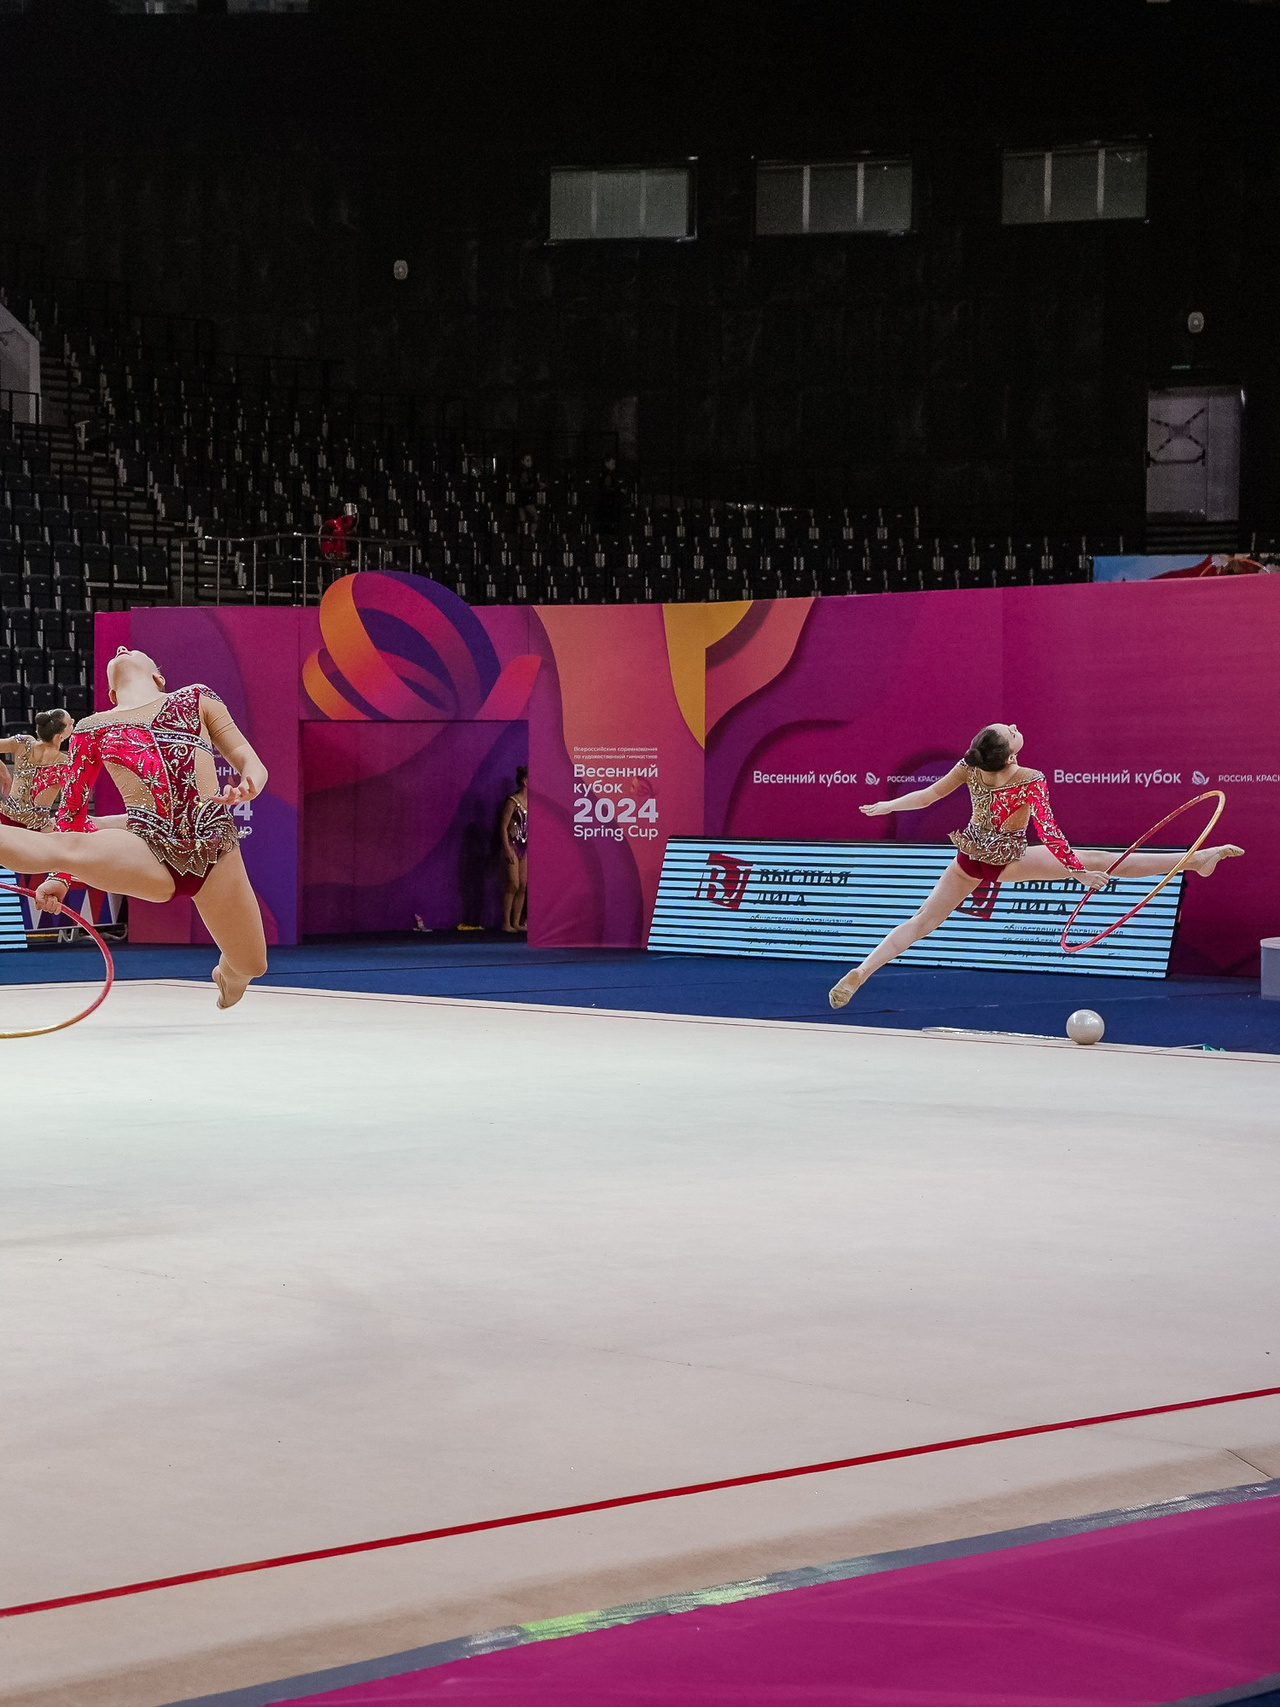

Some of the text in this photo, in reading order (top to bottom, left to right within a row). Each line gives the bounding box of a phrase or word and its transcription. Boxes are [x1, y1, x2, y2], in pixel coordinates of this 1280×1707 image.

[573, 764, 658, 778] Весенний
[753, 770, 857, 787] Весенний кубок
[1053, 769, 1181, 787] Весенний кубок
[573, 779, 623, 797] кубок
[573, 797, 659, 823] 2024
[573, 824, 659, 842] Spring Cup
